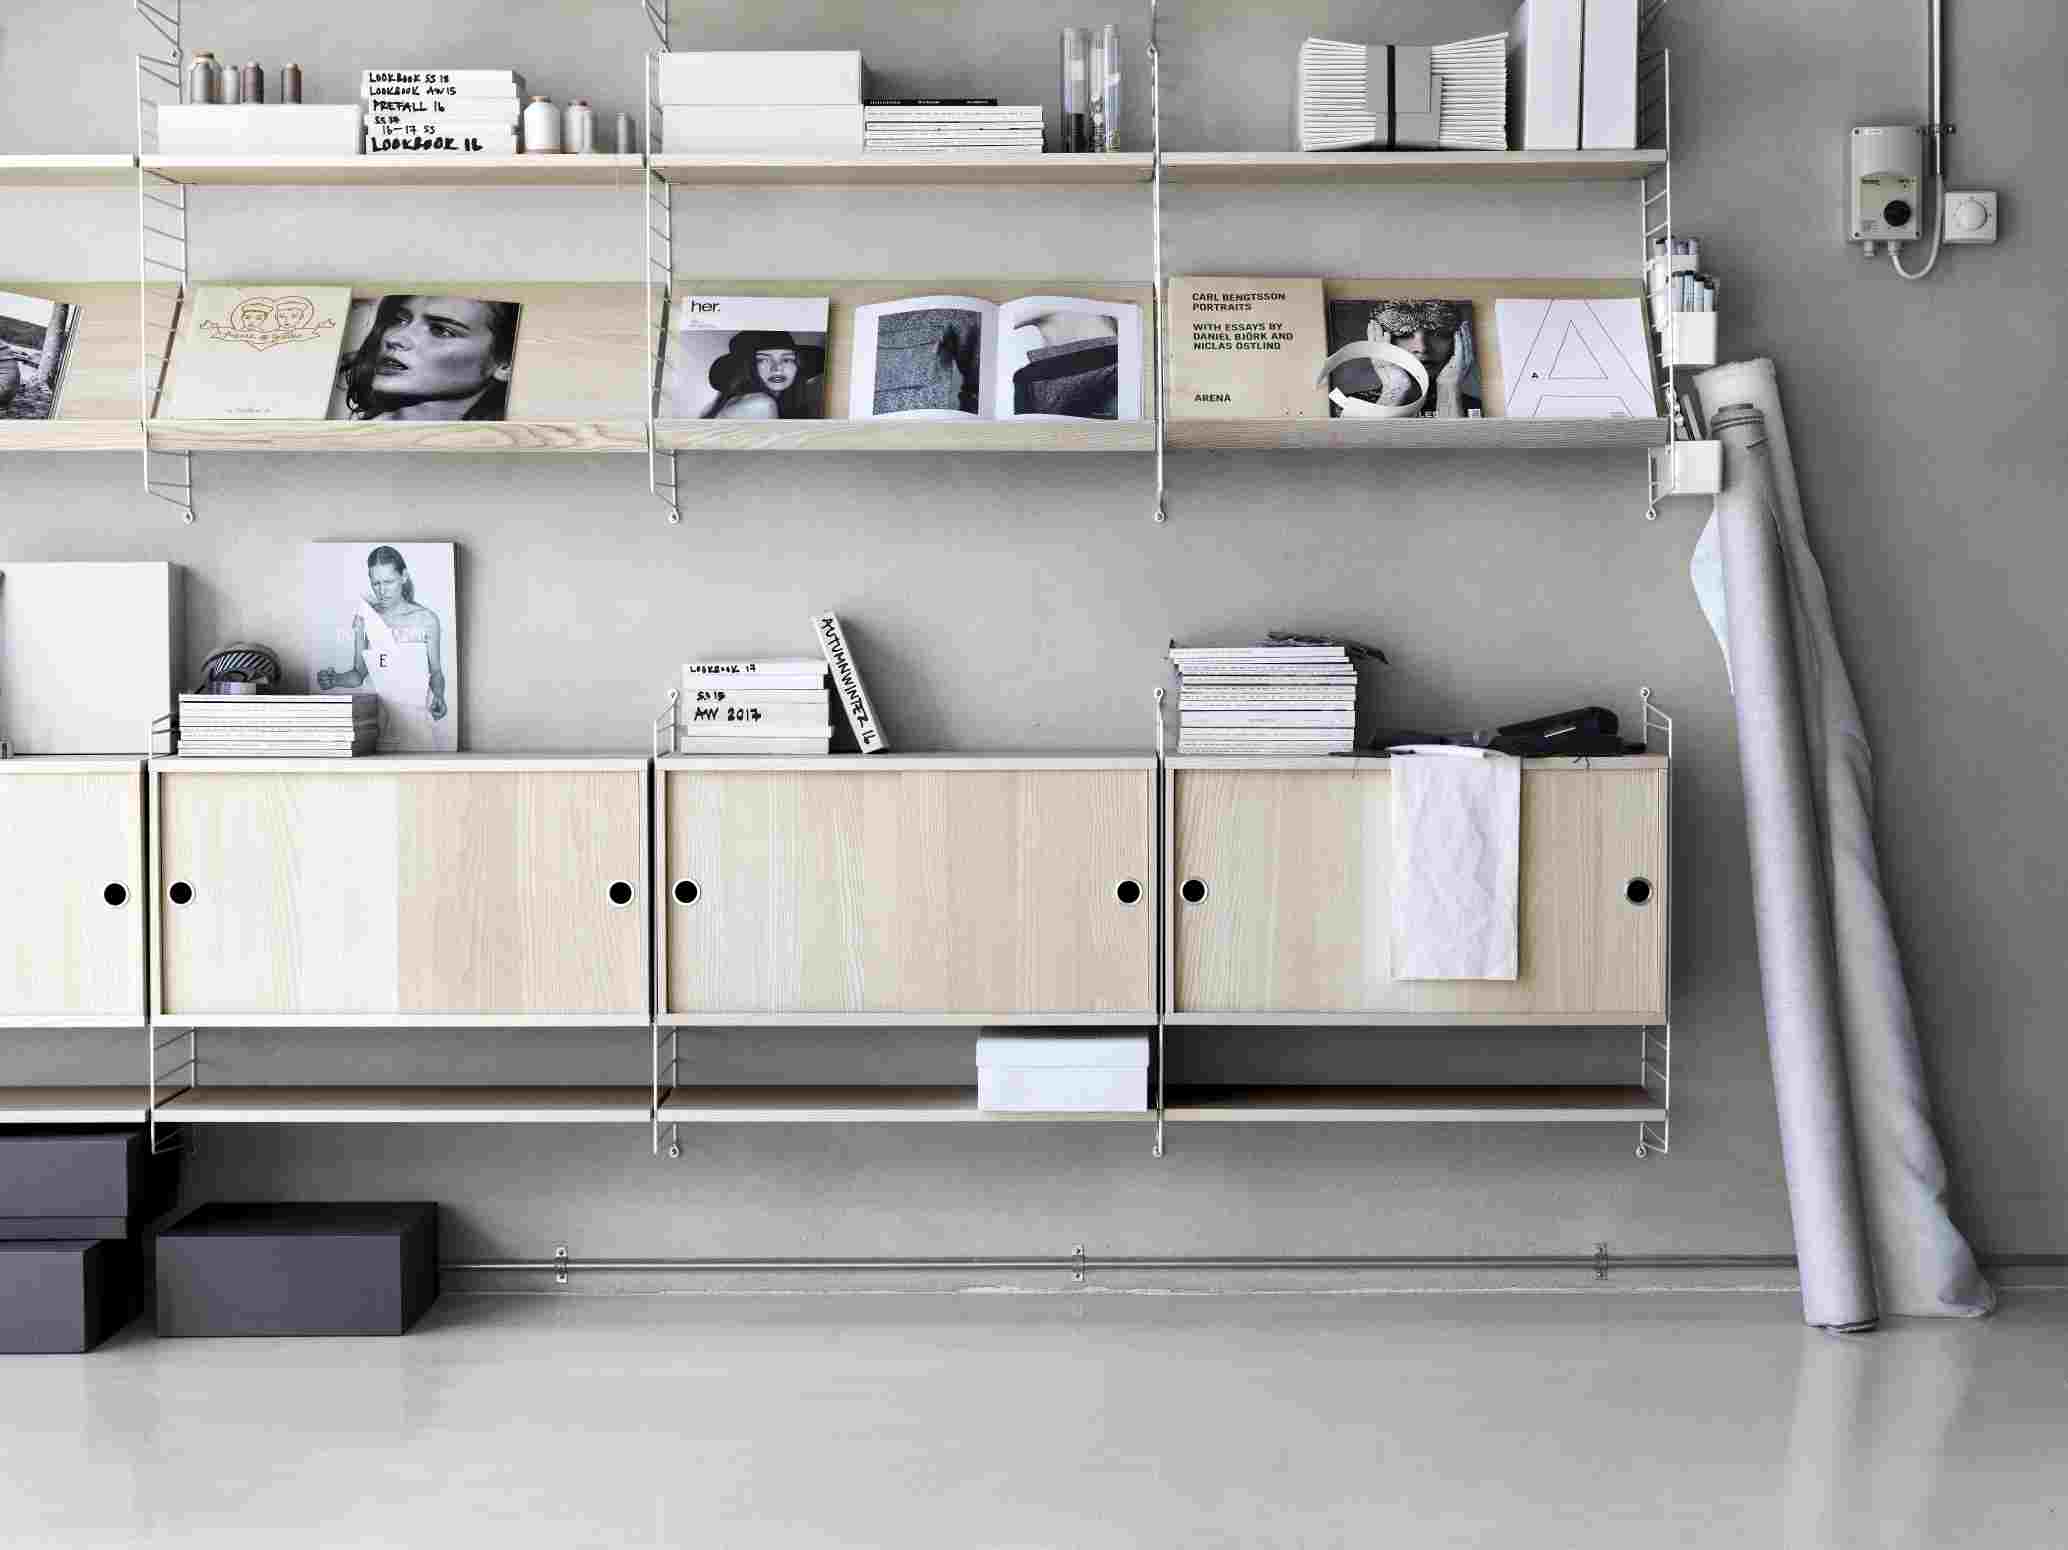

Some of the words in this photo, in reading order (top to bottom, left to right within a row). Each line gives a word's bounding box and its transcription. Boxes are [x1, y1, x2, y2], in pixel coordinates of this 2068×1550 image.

[369, 86, 420, 95] LOOKBOOK
[373, 99, 428, 112] PREFALL
[434, 100, 446, 112] 16
[371, 137, 459, 152] LOOKBOOK
[464, 137, 484, 152] 16
[1192, 293, 1219, 301] CARL
[1192, 303, 1252, 311] PORTRAITS
[1192, 323, 1221, 331] WITH
[1225, 323, 1265, 331] ESSAYS
[1268, 322, 1283, 331] BY
[1193, 332, 1231, 340] DANIEL
[1271, 332, 1294, 341] AND
[1193, 342, 1232, 350] NICLAS
[1194, 394, 1232, 402] ARENA
[380, 653, 388, 668] E
[694, 706, 719, 721] AW
[727, 707, 762, 722] 2017
[861, 729, 876, 745] 16
